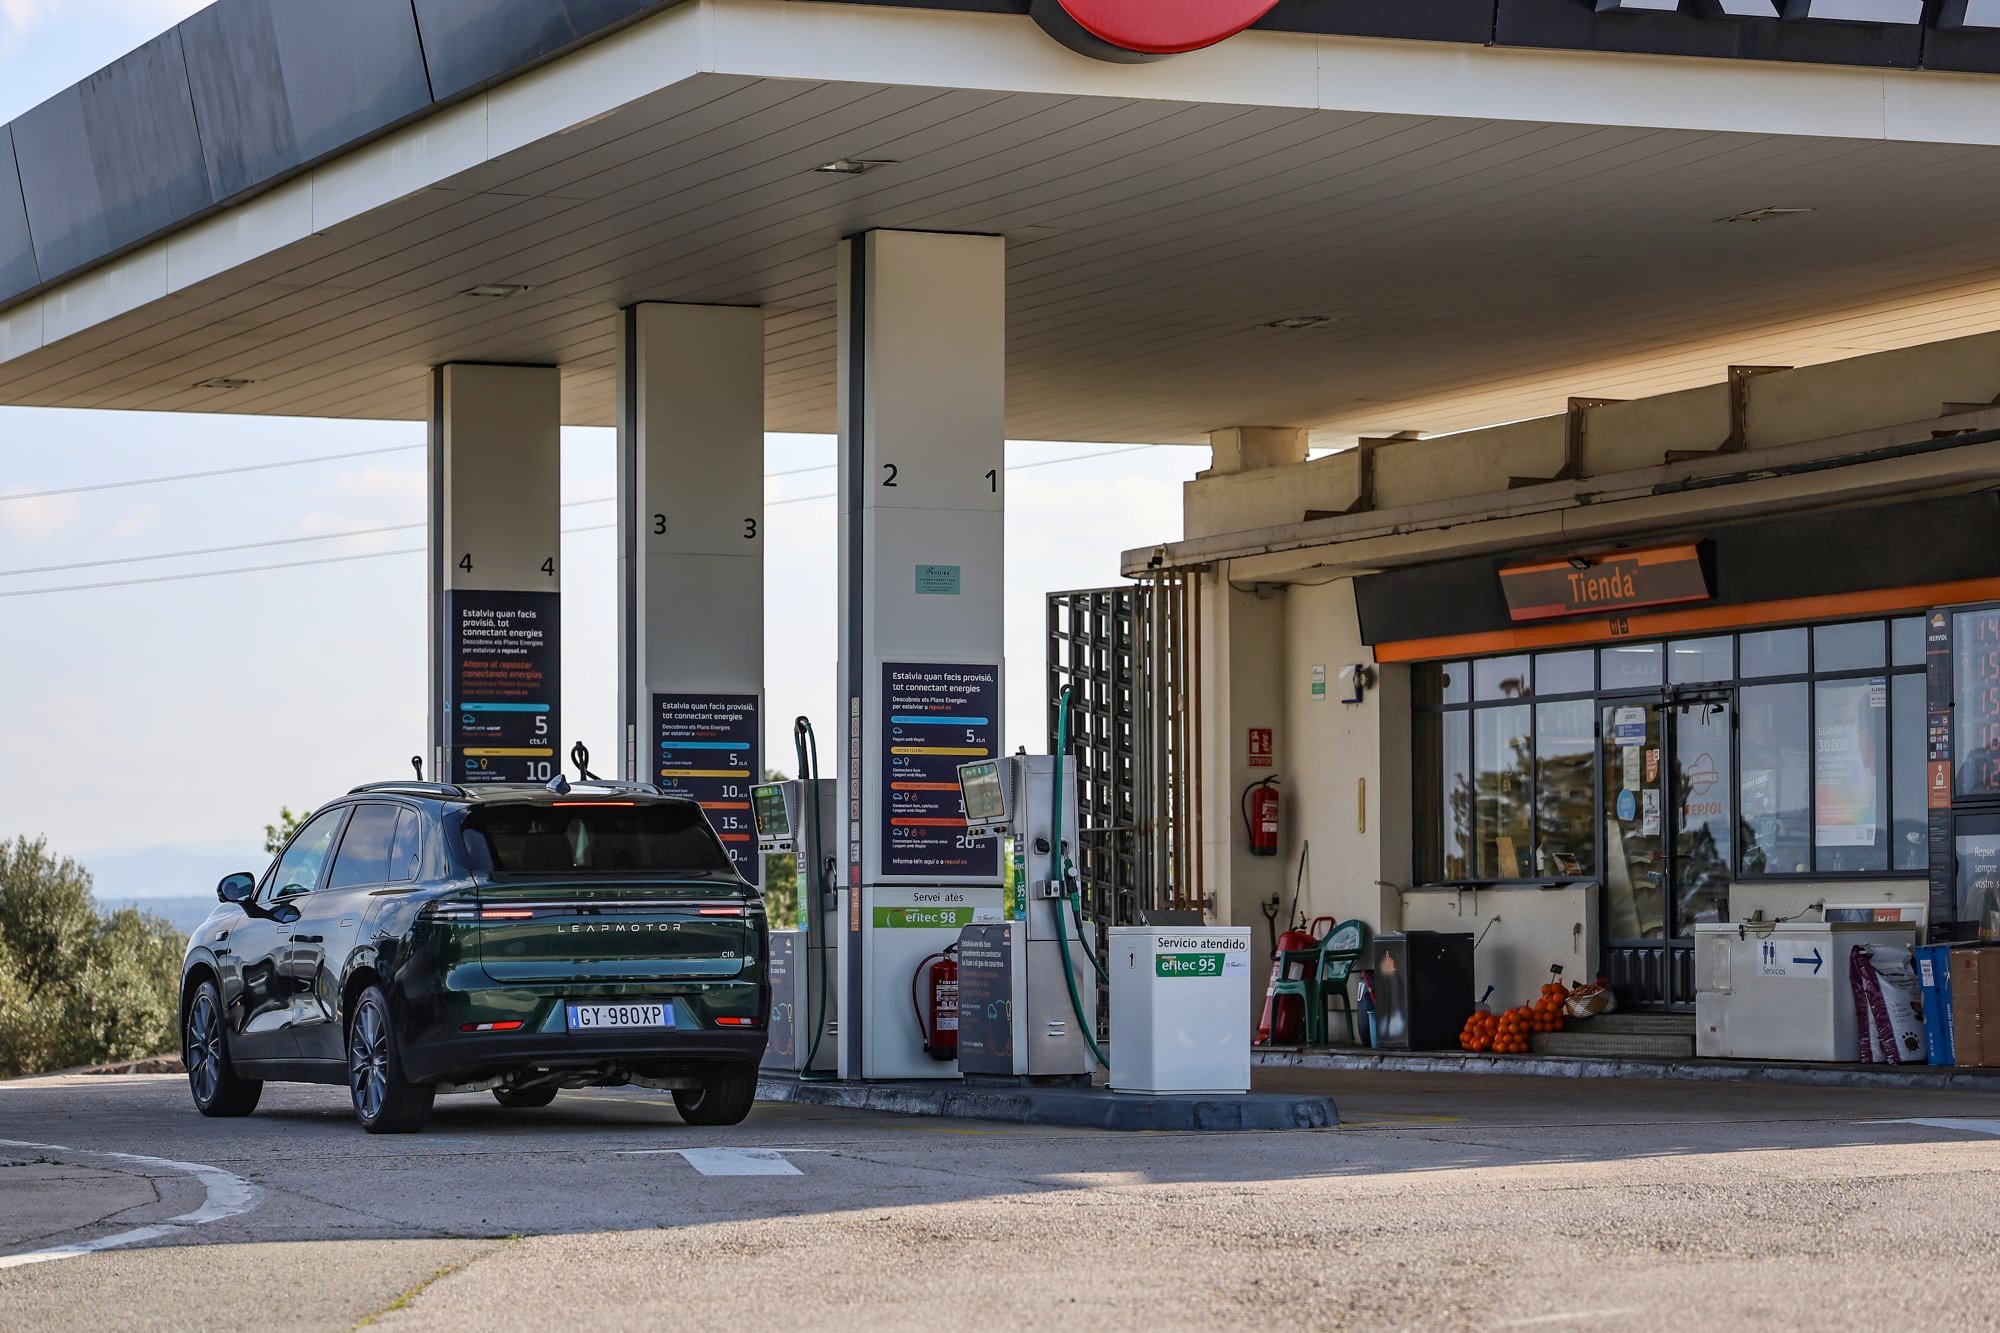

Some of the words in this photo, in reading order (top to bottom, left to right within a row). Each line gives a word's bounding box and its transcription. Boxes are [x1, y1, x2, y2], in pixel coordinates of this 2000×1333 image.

[883, 464, 897, 487] 2
[985, 470, 996, 492] 1
[653, 514, 667, 534] 3
[744, 518, 757, 538] 3
[459, 553, 473, 573] 4
[541, 557, 555, 576] 4
[1567, 566, 1636, 603] Tienda
[463, 609, 494, 617] Estalvia
[496, 611, 515, 619] quan
[518, 610, 536, 618] facis
[463, 619, 495, 628] provisió,
[510, 629, 543, 639] energies
[893, 672, 922, 680] Estalvia
[924, 674, 942, 682] quan
[944, 673, 961, 681] facis
[963, 674, 994, 683] provisió,
[906, 684, 948, 692] connectant
[950, 685, 981, 694] energies
[663, 702, 690, 710] Estalvia
[691, 703, 708, 711] quan
[714, 713, 743, 721] energies
[536, 716, 548, 735] 5
[966, 730, 975, 743] 5
[1818, 739, 1848, 753] 30.000
[730, 754, 738, 766] 5
[527, 762, 551, 781] 10
[722, 786, 738, 798] 10
[959, 800, 965, 813] 1
[722, 817, 738, 829] 15
[956, 836, 975, 849] 20
[729, 850, 738, 862] 0
[1975, 847, 1995, 858] Repsol
[1975, 865, 1997, 877] sempre
[1975, 879, 1994, 889] vostre
[914, 892, 940, 902] Servei
[945, 893, 964, 902] atès
[1017, 884, 1025, 898] 95
[906, 913, 938, 923] efitec
[940, 912, 956, 924] 98
[558, 924, 681, 933] LEAPMOTOR
[1158, 938, 1198, 949] Servicio
[1201, 938, 1245, 950] atendido
[1129, 953, 1134, 967] 1
[1162, 960, 1197, 971] efitec
[1199, 959, 1216, 972] 95
[1762, 966, 1786, 976] Servicios
